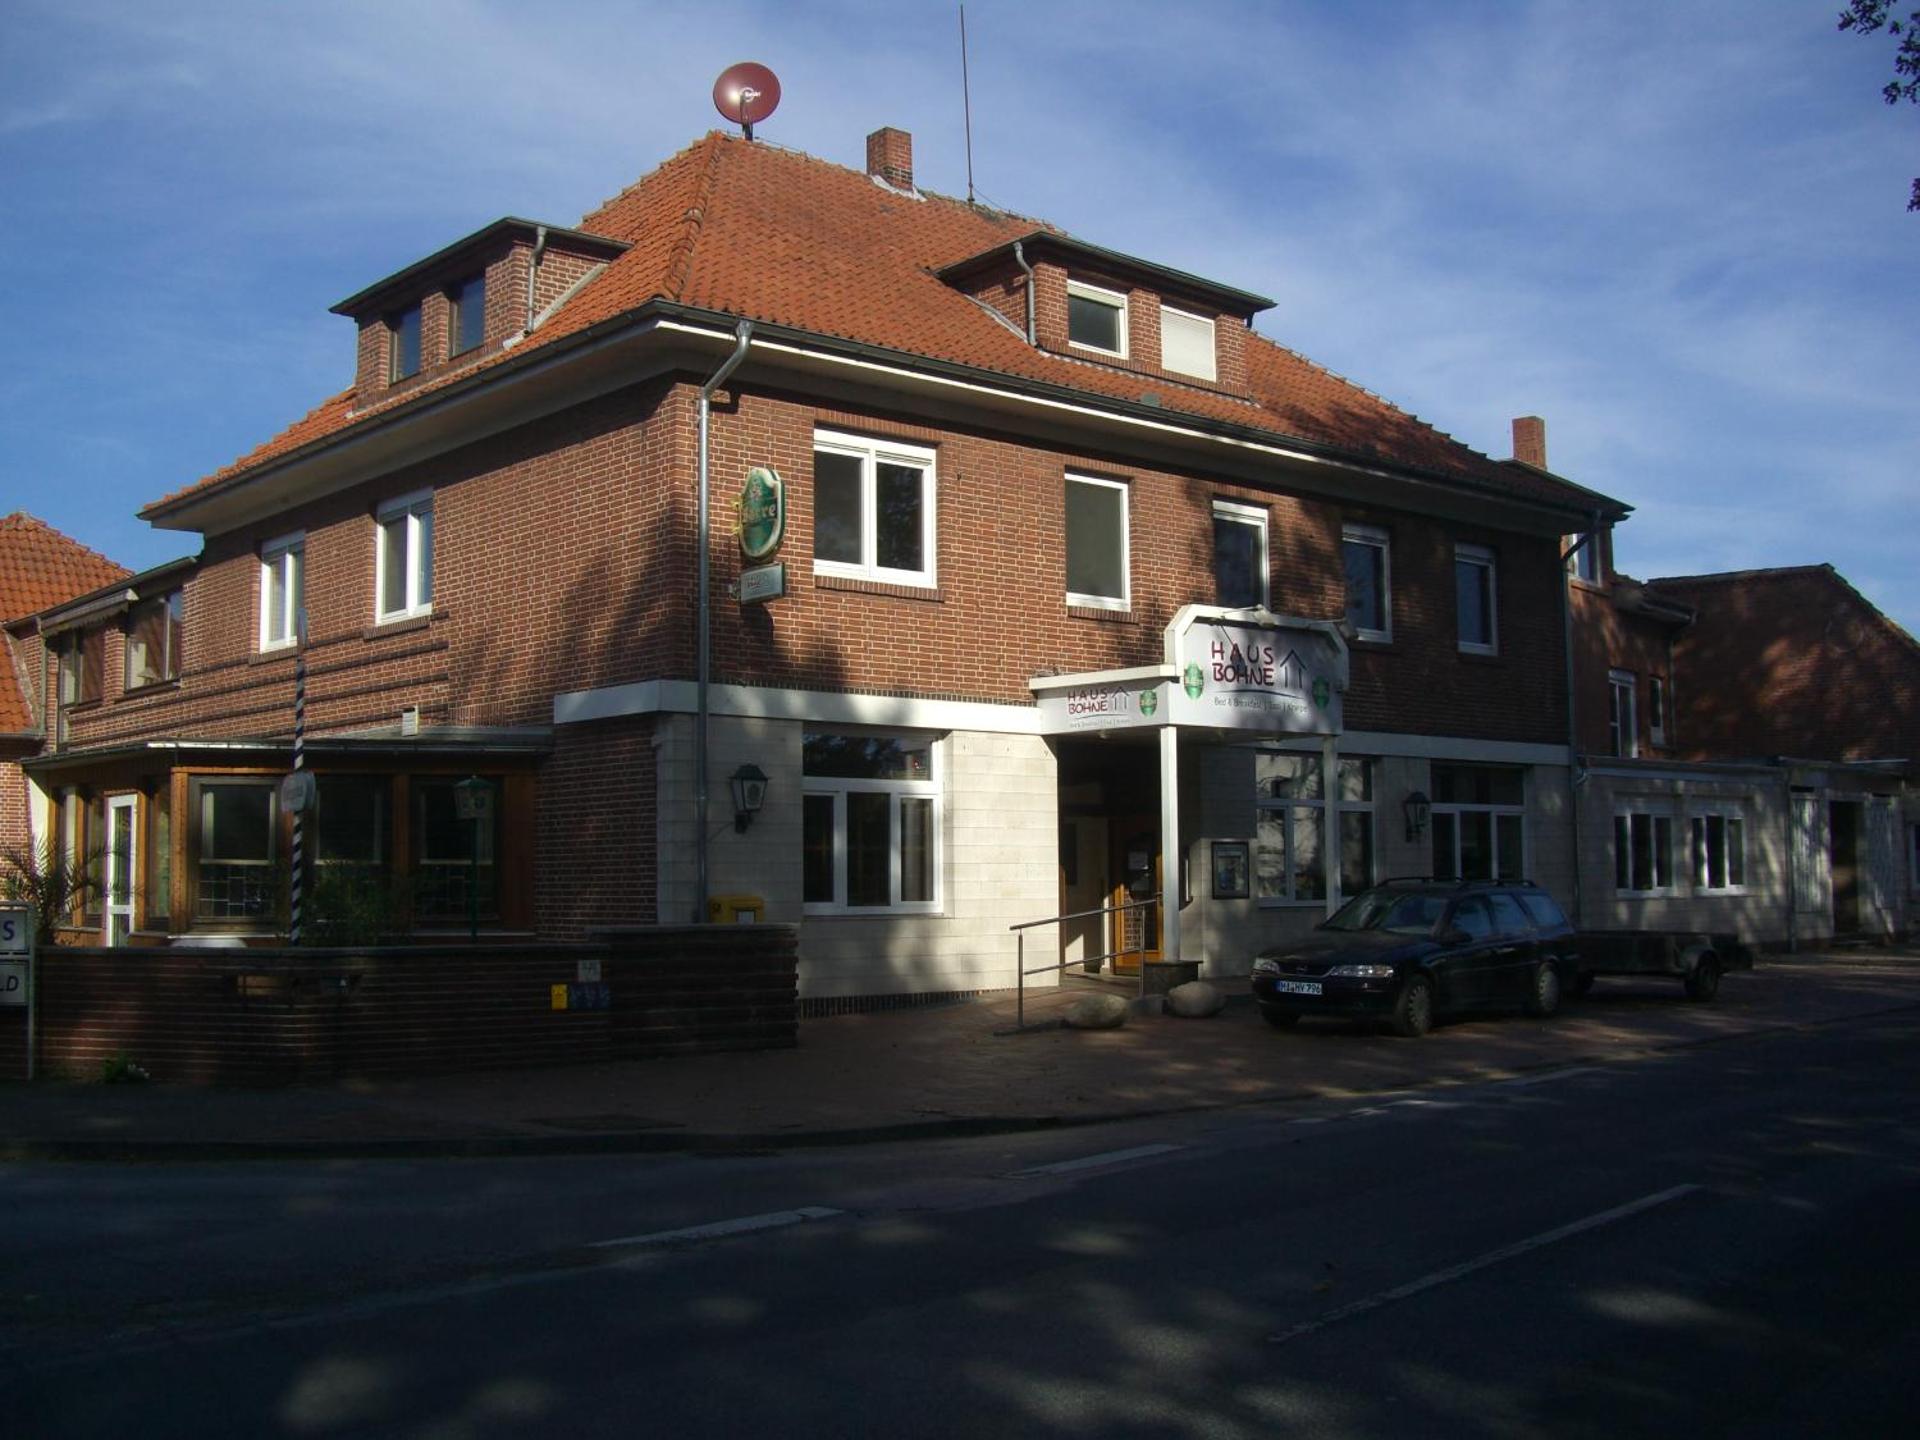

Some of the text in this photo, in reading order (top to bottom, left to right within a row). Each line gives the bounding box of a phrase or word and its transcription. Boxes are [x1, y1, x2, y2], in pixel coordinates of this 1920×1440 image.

[1211, 641, 1274, 665] HAUS
[1212, 662, 1274, 686] BOHNE
[1067, 688, 1108, 702] HAUS
[1068, 700, 1108, 714] BOHNE
